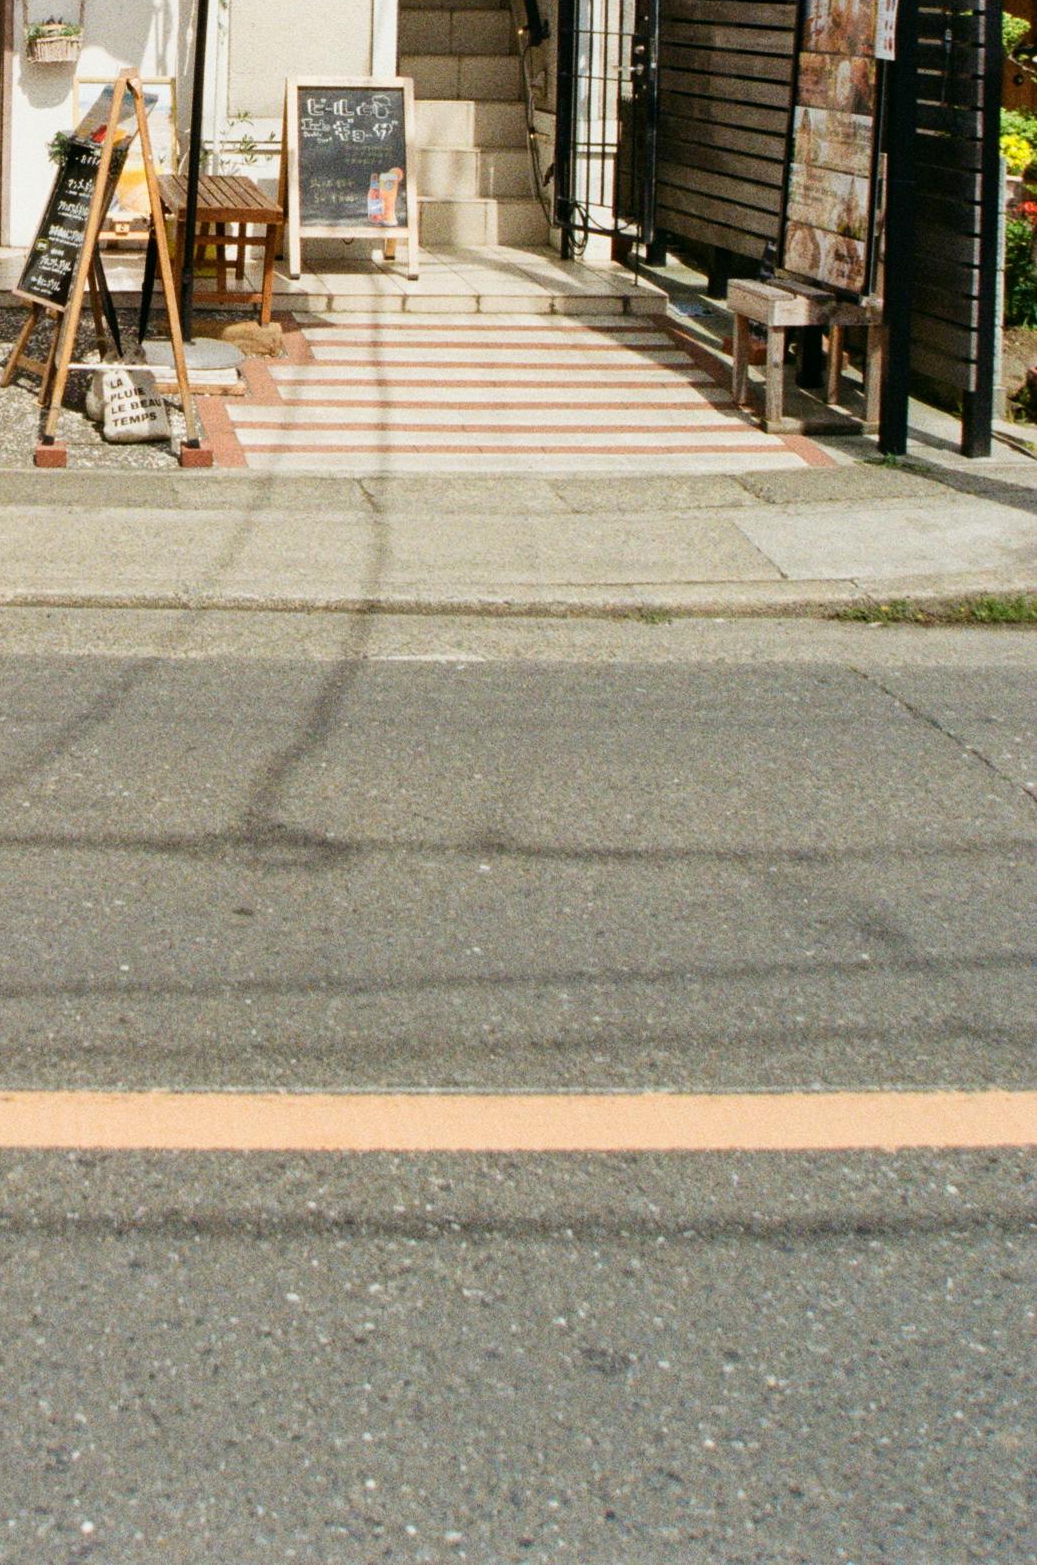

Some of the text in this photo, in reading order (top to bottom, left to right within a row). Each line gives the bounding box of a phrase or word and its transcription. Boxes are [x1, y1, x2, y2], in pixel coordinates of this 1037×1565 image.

[109, 378, 124, 389] LA
[110, 386, 147, 402] PLUIE
[111, 398, 162, 415] LE BEAU
[112, 411, 158, 428] TEMPS
